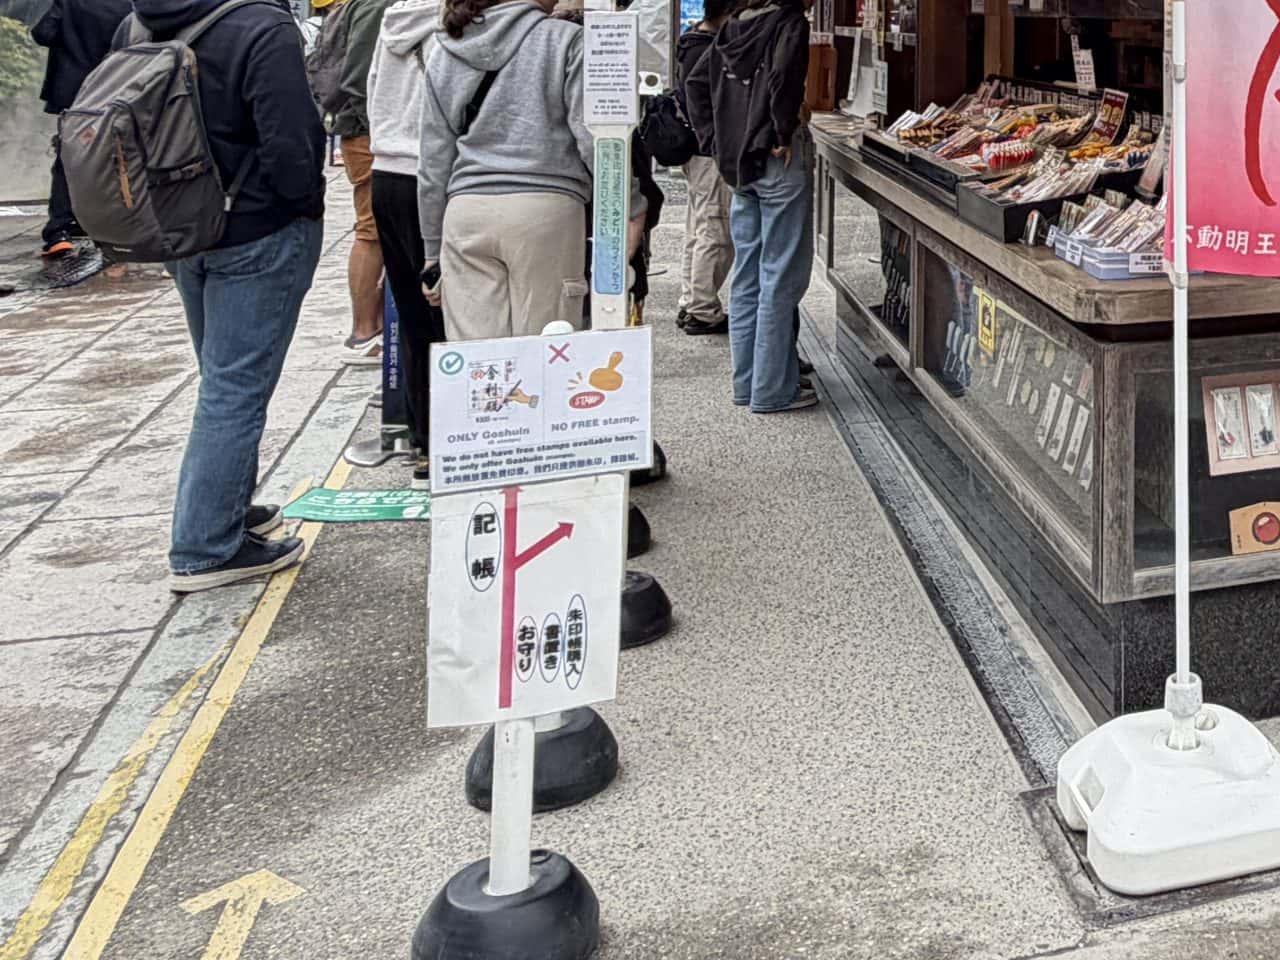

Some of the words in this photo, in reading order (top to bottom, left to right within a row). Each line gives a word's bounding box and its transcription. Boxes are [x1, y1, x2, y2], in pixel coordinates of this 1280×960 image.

[447, 431, 479, 444] ONLY
[482, 426, 530, 440] Goshuin
[551, 423, 568, 432] NO
[571, 419, 600, 430] FREE
[603, 415, 640, 425] stamp.
[491, 449, 513, 457] have
[537, 443, 570, 452] stamps
[572, 436, 612, 447] available
[459, 463, 479, 471] only
[481, 460, 503, 468] offer
[505, 456, 543, 465] Goshuin
[471, 513, 496, 581] 記帳
[518, 625, 536, 672] お守り
[544, 624, 560, 670] 書置き
[566, 609, 583, 677] 朱印帳購入
